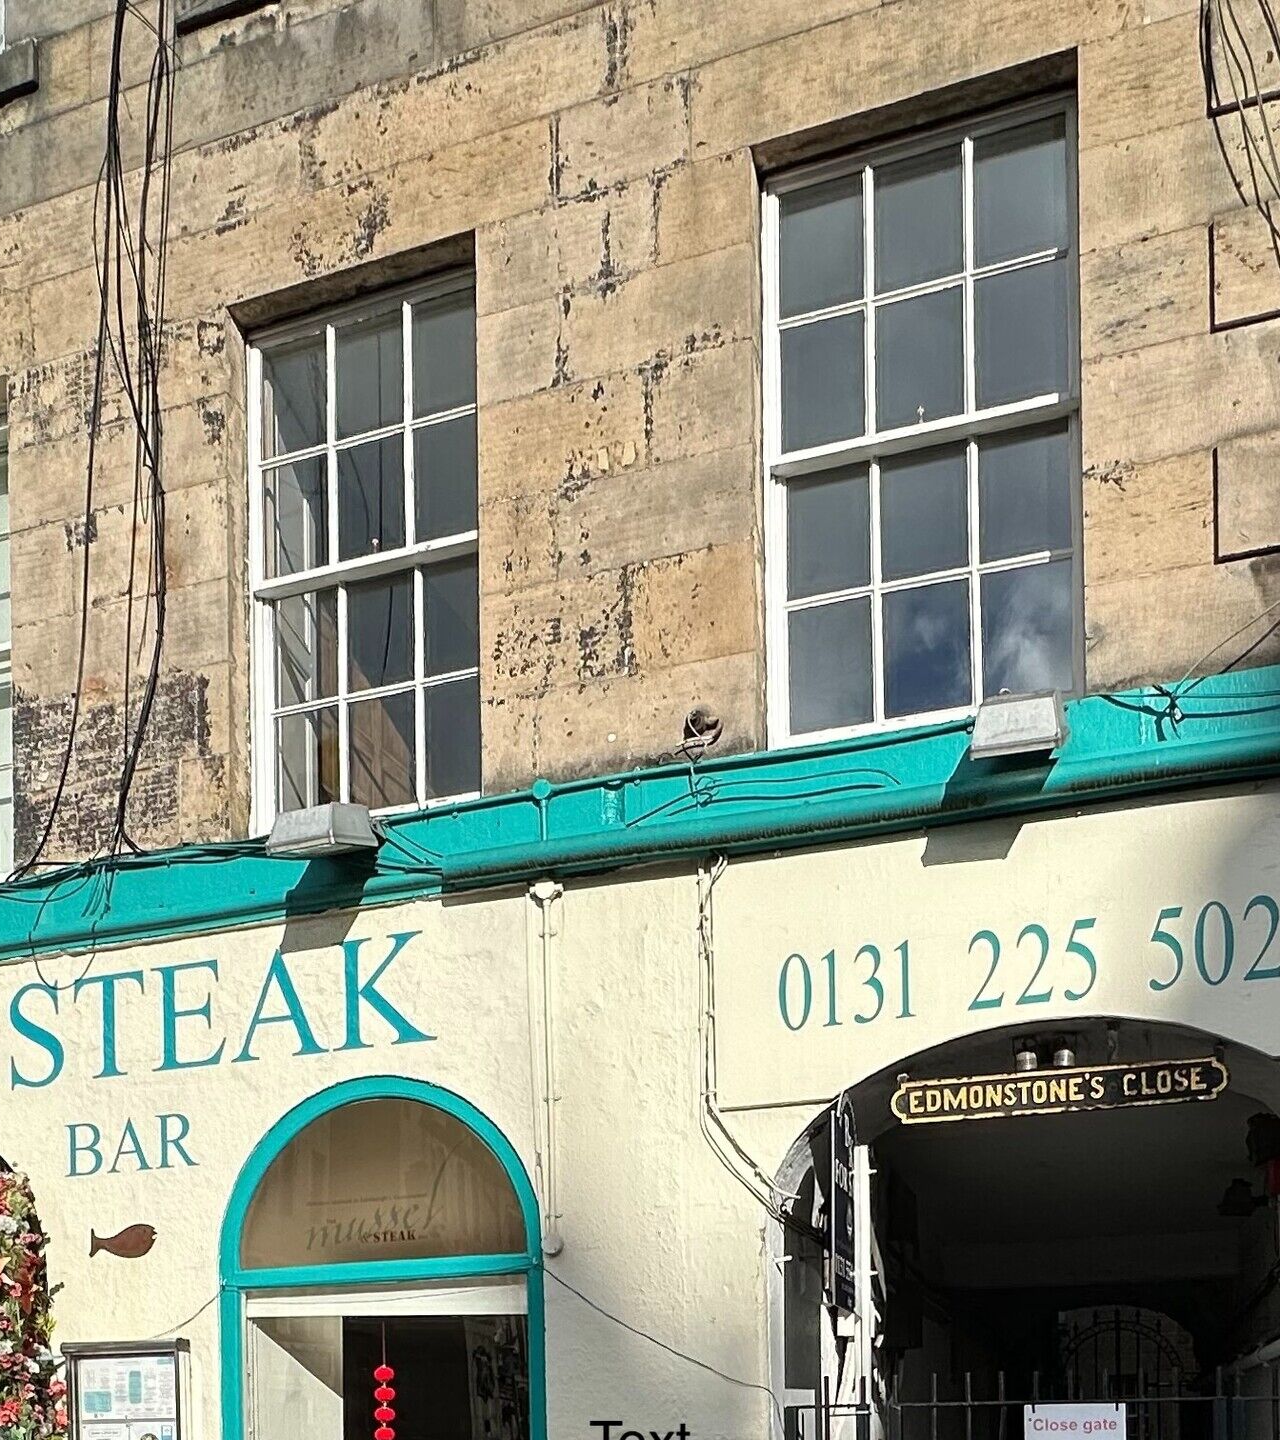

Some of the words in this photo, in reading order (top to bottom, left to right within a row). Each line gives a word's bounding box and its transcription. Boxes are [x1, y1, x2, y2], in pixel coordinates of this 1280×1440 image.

[778, 939, 917, 1031] 0131
[966, 917, 1098, 1011] 225
[8, 929, 438, 1092] STEAK
[908, 1072, 1106, 1115] EDMONSTONE'S
[1122, 1066, 1209, 1097] CLOSE
[64, 1112, 200, 1179] BAR
[373, 1229, 417, 1243] STEAK
[1033, 1418, 1078, 1432] Close
[1083, 1419, 1118, 1434] gate
